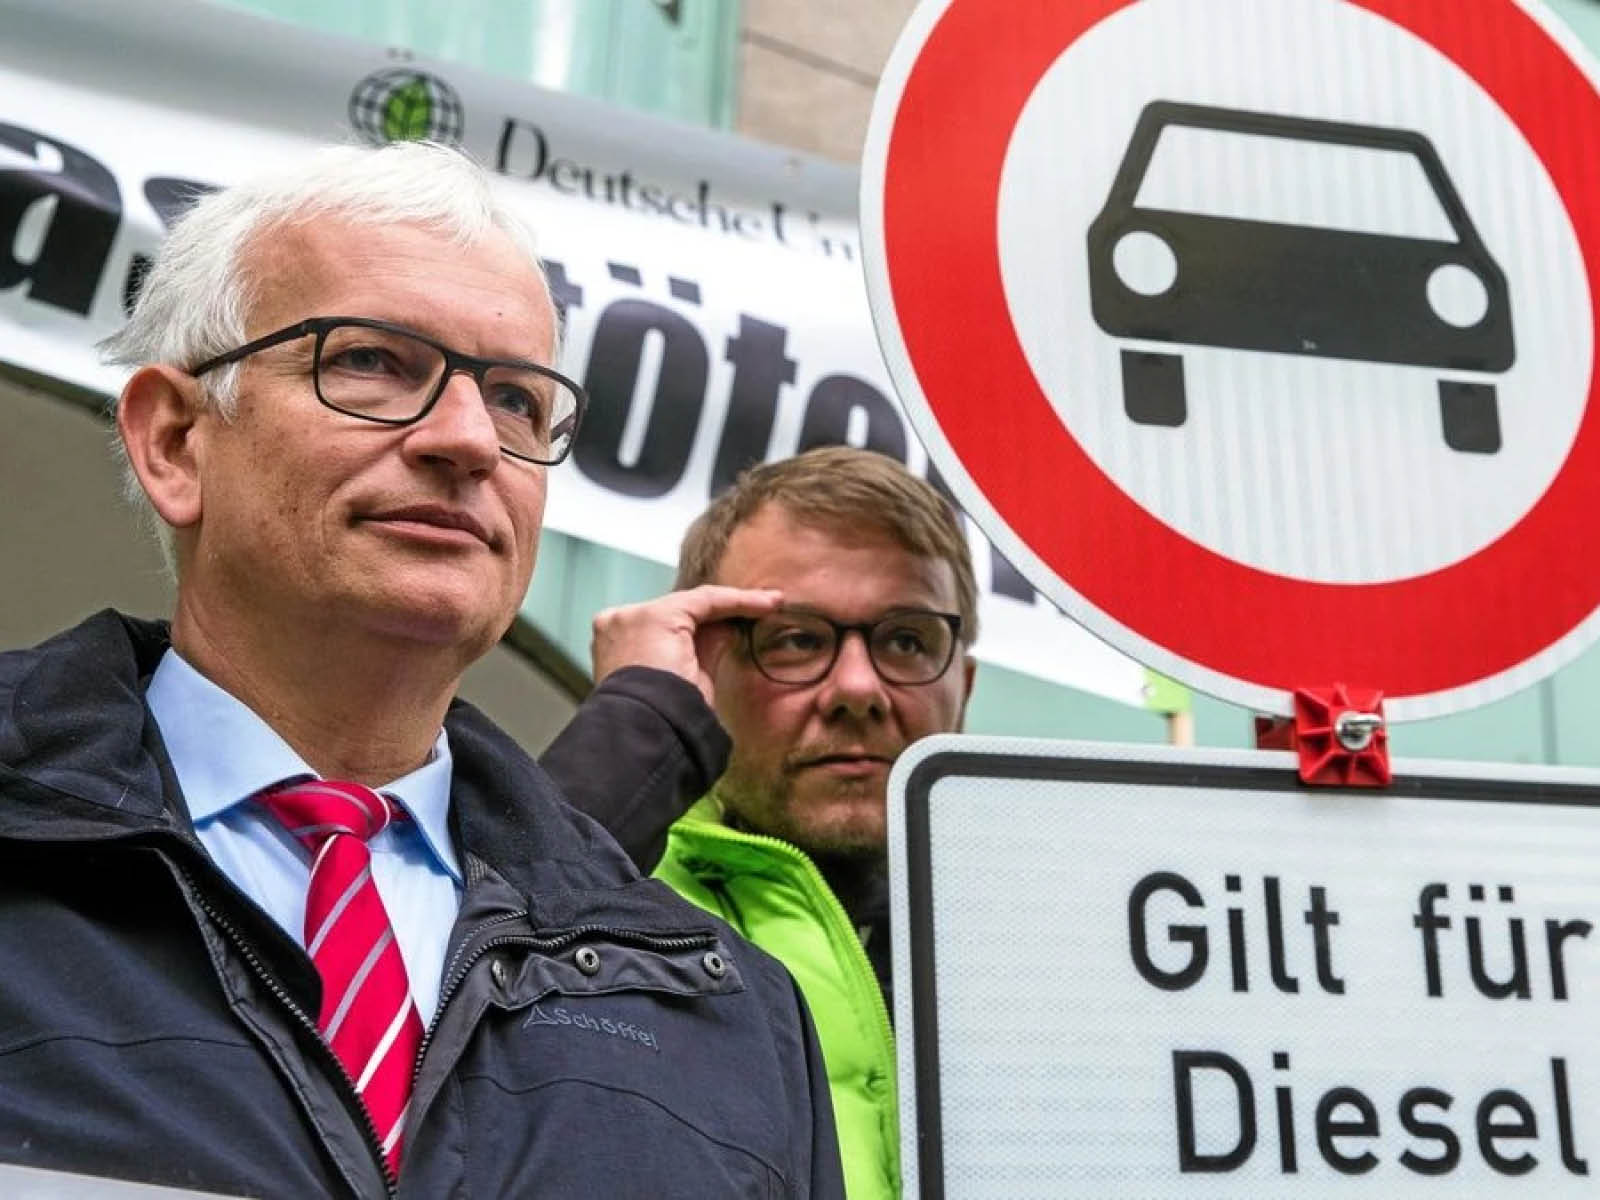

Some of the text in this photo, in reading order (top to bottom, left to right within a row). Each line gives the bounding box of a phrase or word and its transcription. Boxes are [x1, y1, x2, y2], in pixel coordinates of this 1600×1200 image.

[495, 117, 763, 238] Deutsche
[1128, 871, 1594, 1000] Gilt für
[1172, 1049, 1590, 1177] Diesel
